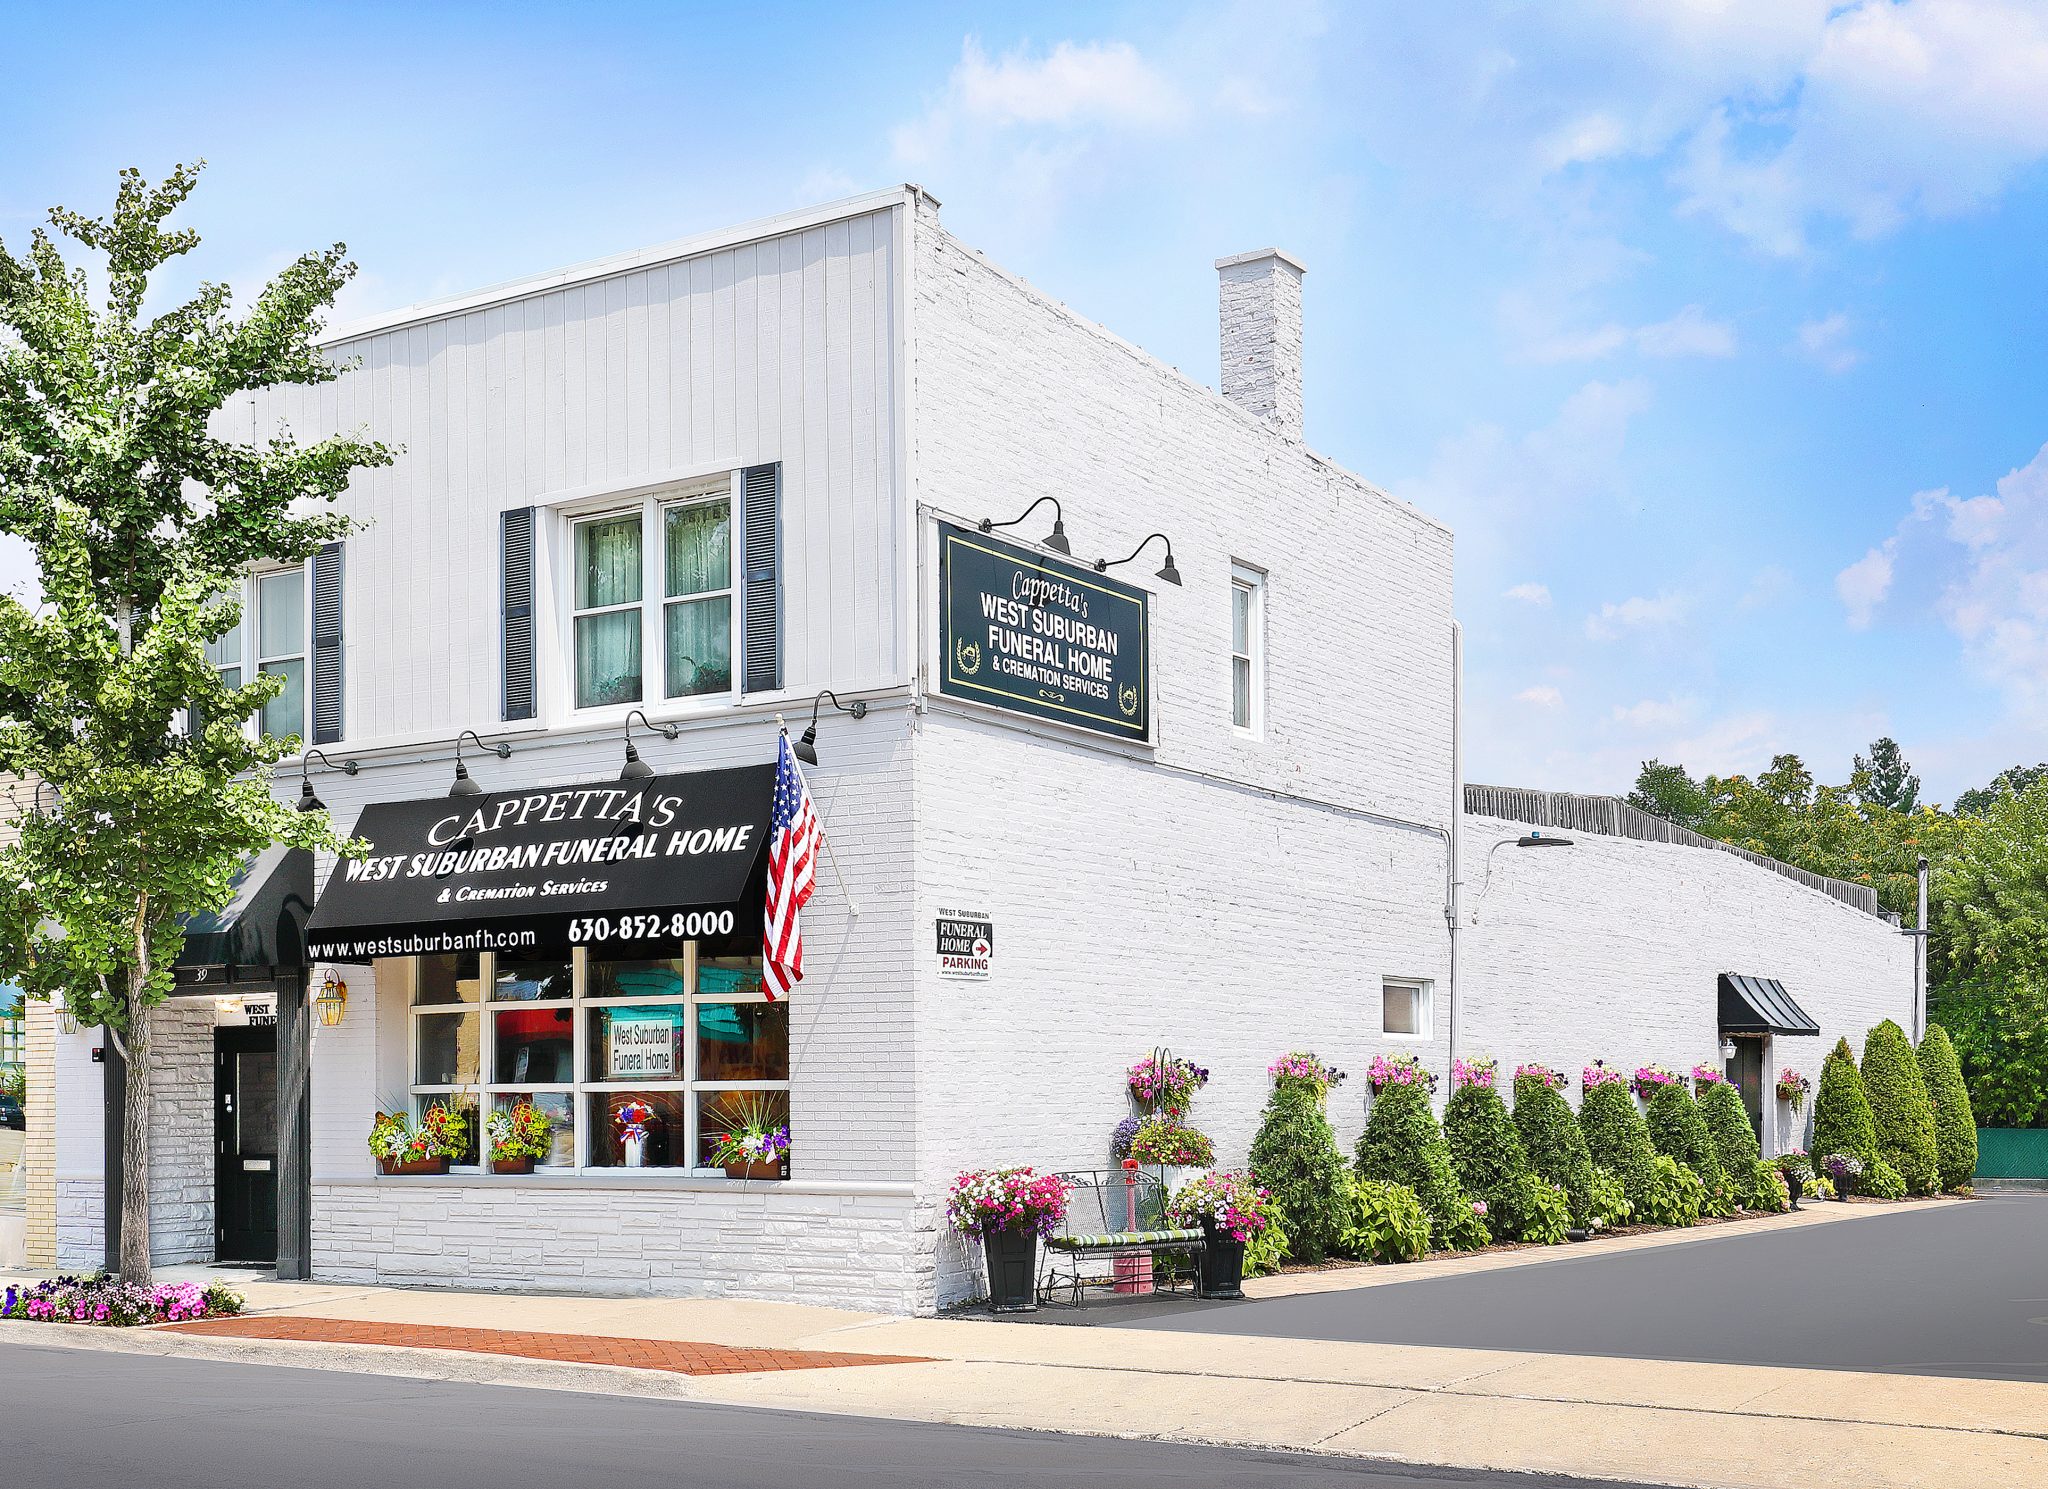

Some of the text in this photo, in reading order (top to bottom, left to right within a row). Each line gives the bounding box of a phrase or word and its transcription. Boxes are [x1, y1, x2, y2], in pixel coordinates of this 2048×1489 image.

[1012, 570, 1089, 619] Cappetta's
[980, 591, 1118, 656] WEST SUBURBAN
[988, 624, 1113, 682] FUNERAL HOME
[992, 655, 1109, 700] & CREMATION SERVICES
[427, 789, 683, 847] CAPPETTA'S
[345, 824, 754, 883] WEST SUBURBAN FUNERAL HOME
[436, 887, 452, 904] &
[939, 907, 990, 919] WEST SUBURBAN
[568, 910, 734, 943] 630-852-8000
[940, 922, 988, 939] FUNERAL
[308, 929, 536, 958] www.westsuburbanfh.com
[940, 937, 971, 953] HOME
[942, 956, 988, 970] PARKING
[195, 968, 208, 982] 39
[244, 1004, 270, 1015] WEST
[249, 1016, 277, 1026] FUNE
[614, 1024, 669, 1046] West Suburban
[613, 1048, 669, 1071] Funeral Home
